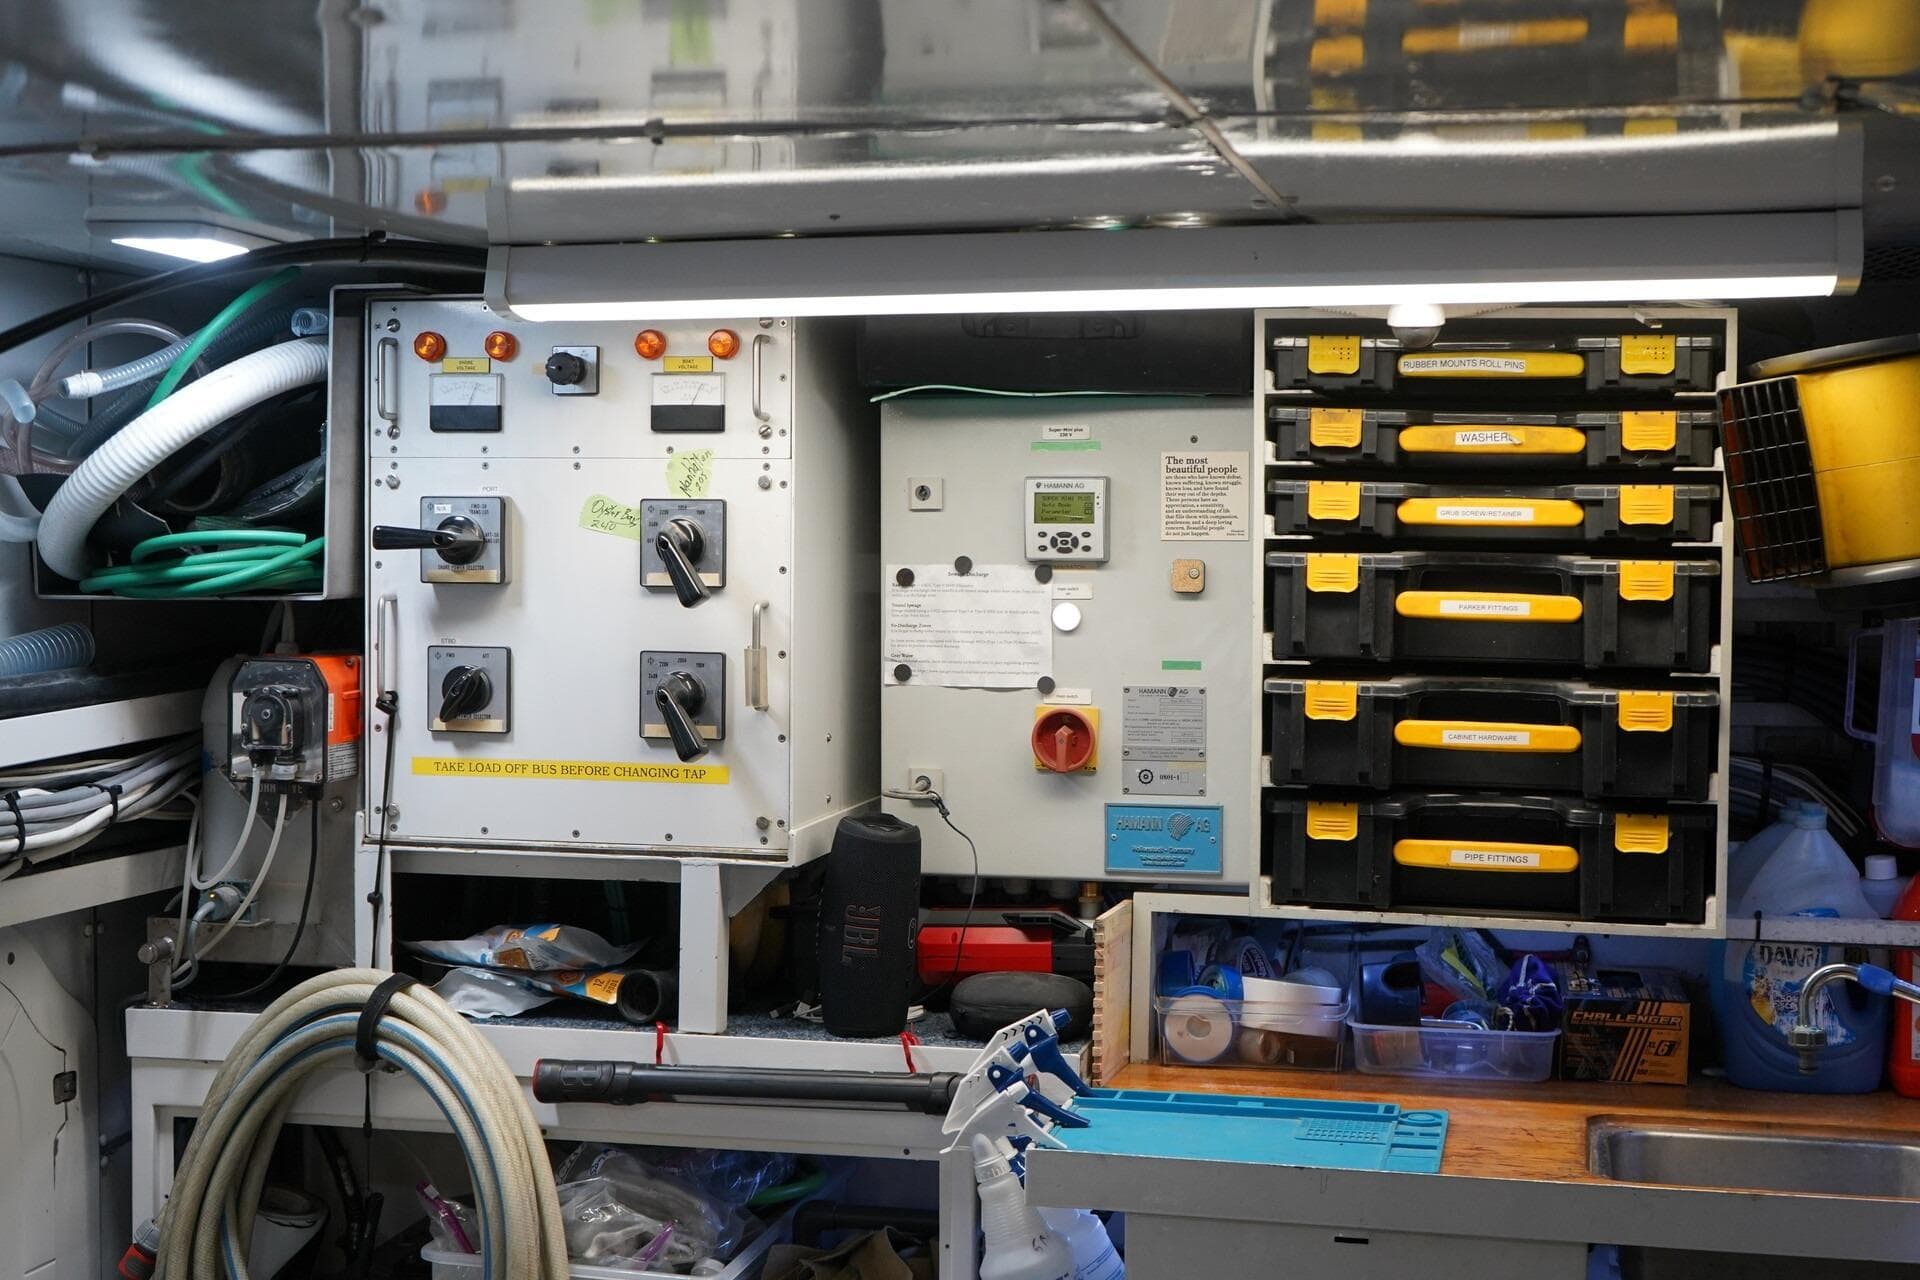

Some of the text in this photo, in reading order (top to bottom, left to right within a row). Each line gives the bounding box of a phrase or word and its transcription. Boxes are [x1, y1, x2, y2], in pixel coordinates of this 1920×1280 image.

[1404, 359, 1524, 370] RUBBER MOUNTS ROLL PINS
[1165, 456, 1184, 464] The
[1166, 465, 1238, 475] beautiful people
[434, 762, 706, 779] TAKE LOAD OFF BUS BEFORE CHANGING TAP
[1114, 816, 1211, 833] HAMANN AG
[1464, 853, 1528, 864] PIPE FITTINGS
[842, 904, 880, 962] JBL
[593, 978, 605, 988] 12
[1572, 1011, 1682, 1026] CHALLENGER
